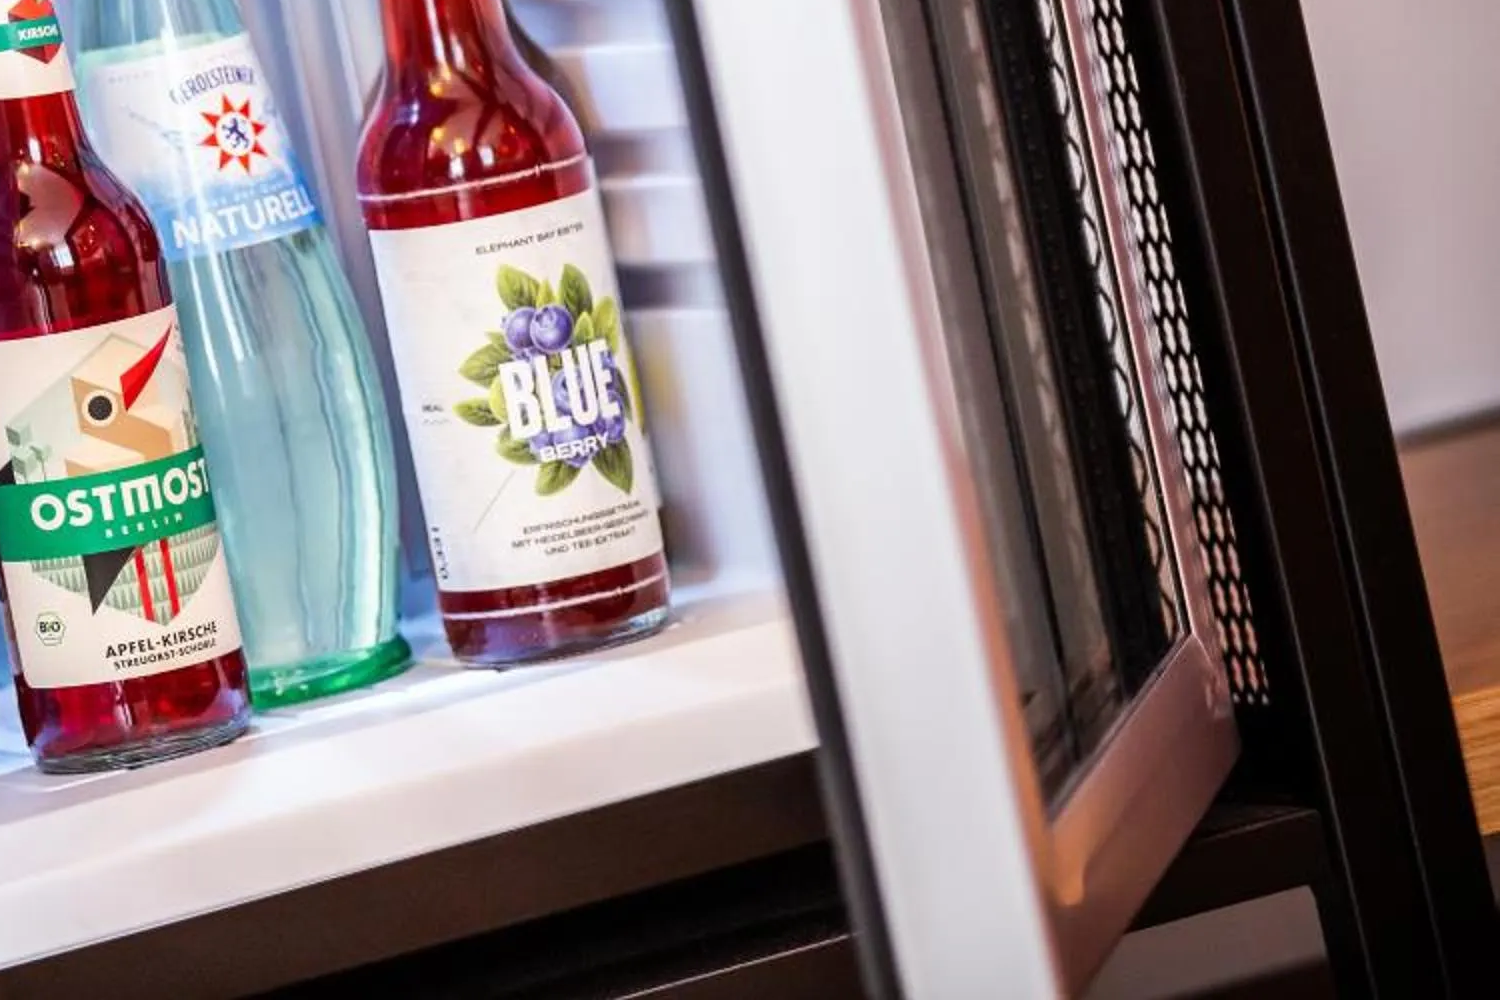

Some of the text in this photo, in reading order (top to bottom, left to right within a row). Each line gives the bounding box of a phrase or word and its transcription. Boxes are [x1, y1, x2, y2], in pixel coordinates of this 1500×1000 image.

[499, 338, 620, 441] BLUE
[540, 431, 608, 463] BERRY
[105, 512, 183, 539] BERLIN
[105, 620, 217, 659] APFEL-KIRSCHE
